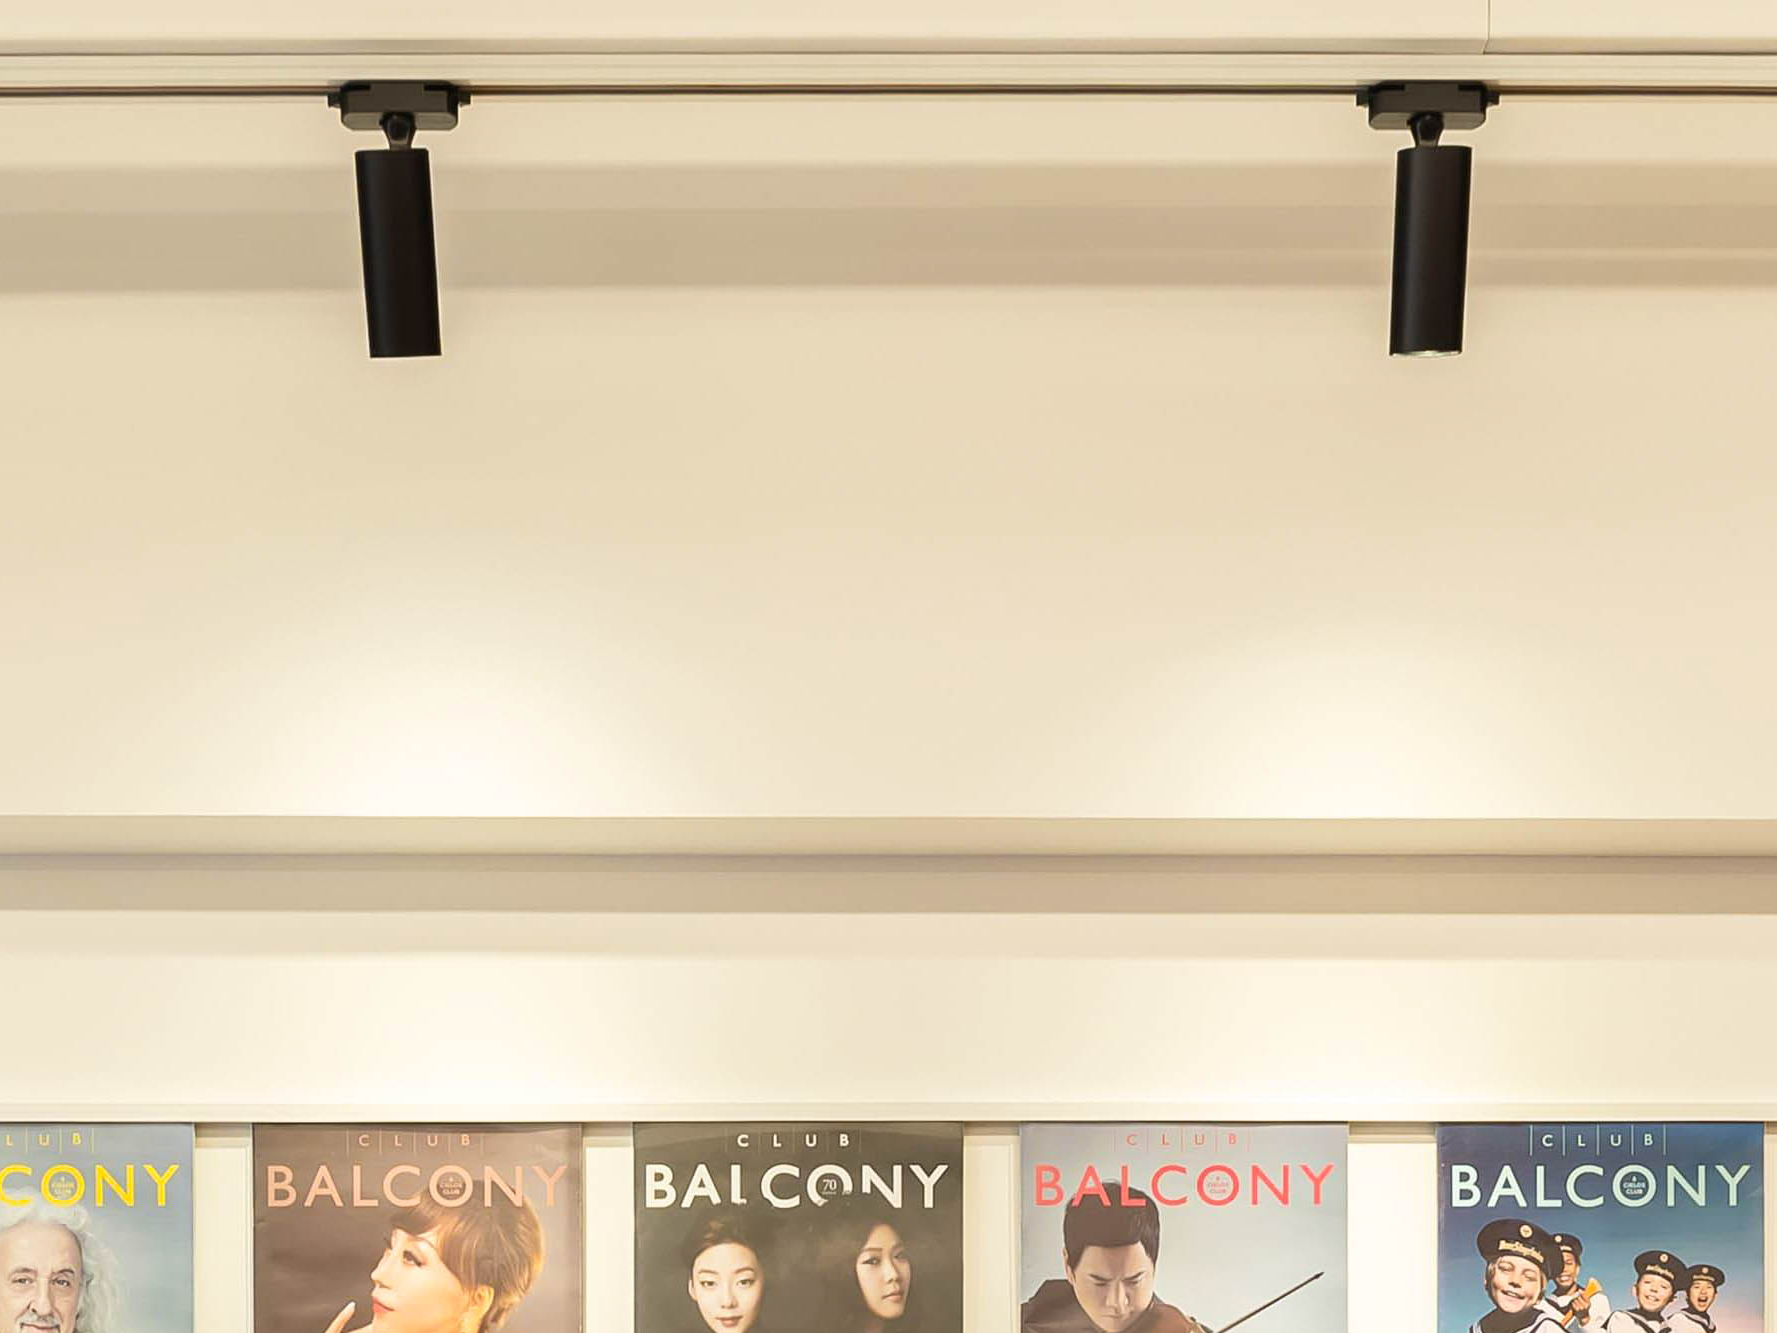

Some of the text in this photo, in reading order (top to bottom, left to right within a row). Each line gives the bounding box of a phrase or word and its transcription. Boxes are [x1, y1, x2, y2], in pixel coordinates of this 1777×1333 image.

[359, 1134, 471, 1147] CLUB
[738, 1134, 850, 1147] CLUB
[1127, 1133, 1237, 1146] CLUB
[1542, 1133, 1653, 1147] CLUB
[267, 1165, 567, 1207] BALCONY
[645, 1164, 949, 1208] BALCONY
[823, 1178, 836, 1191] 70
[1035, 1165, 1335, 1207] BALCONY
[1451, 1165, 1751, 1207] BALCONY
